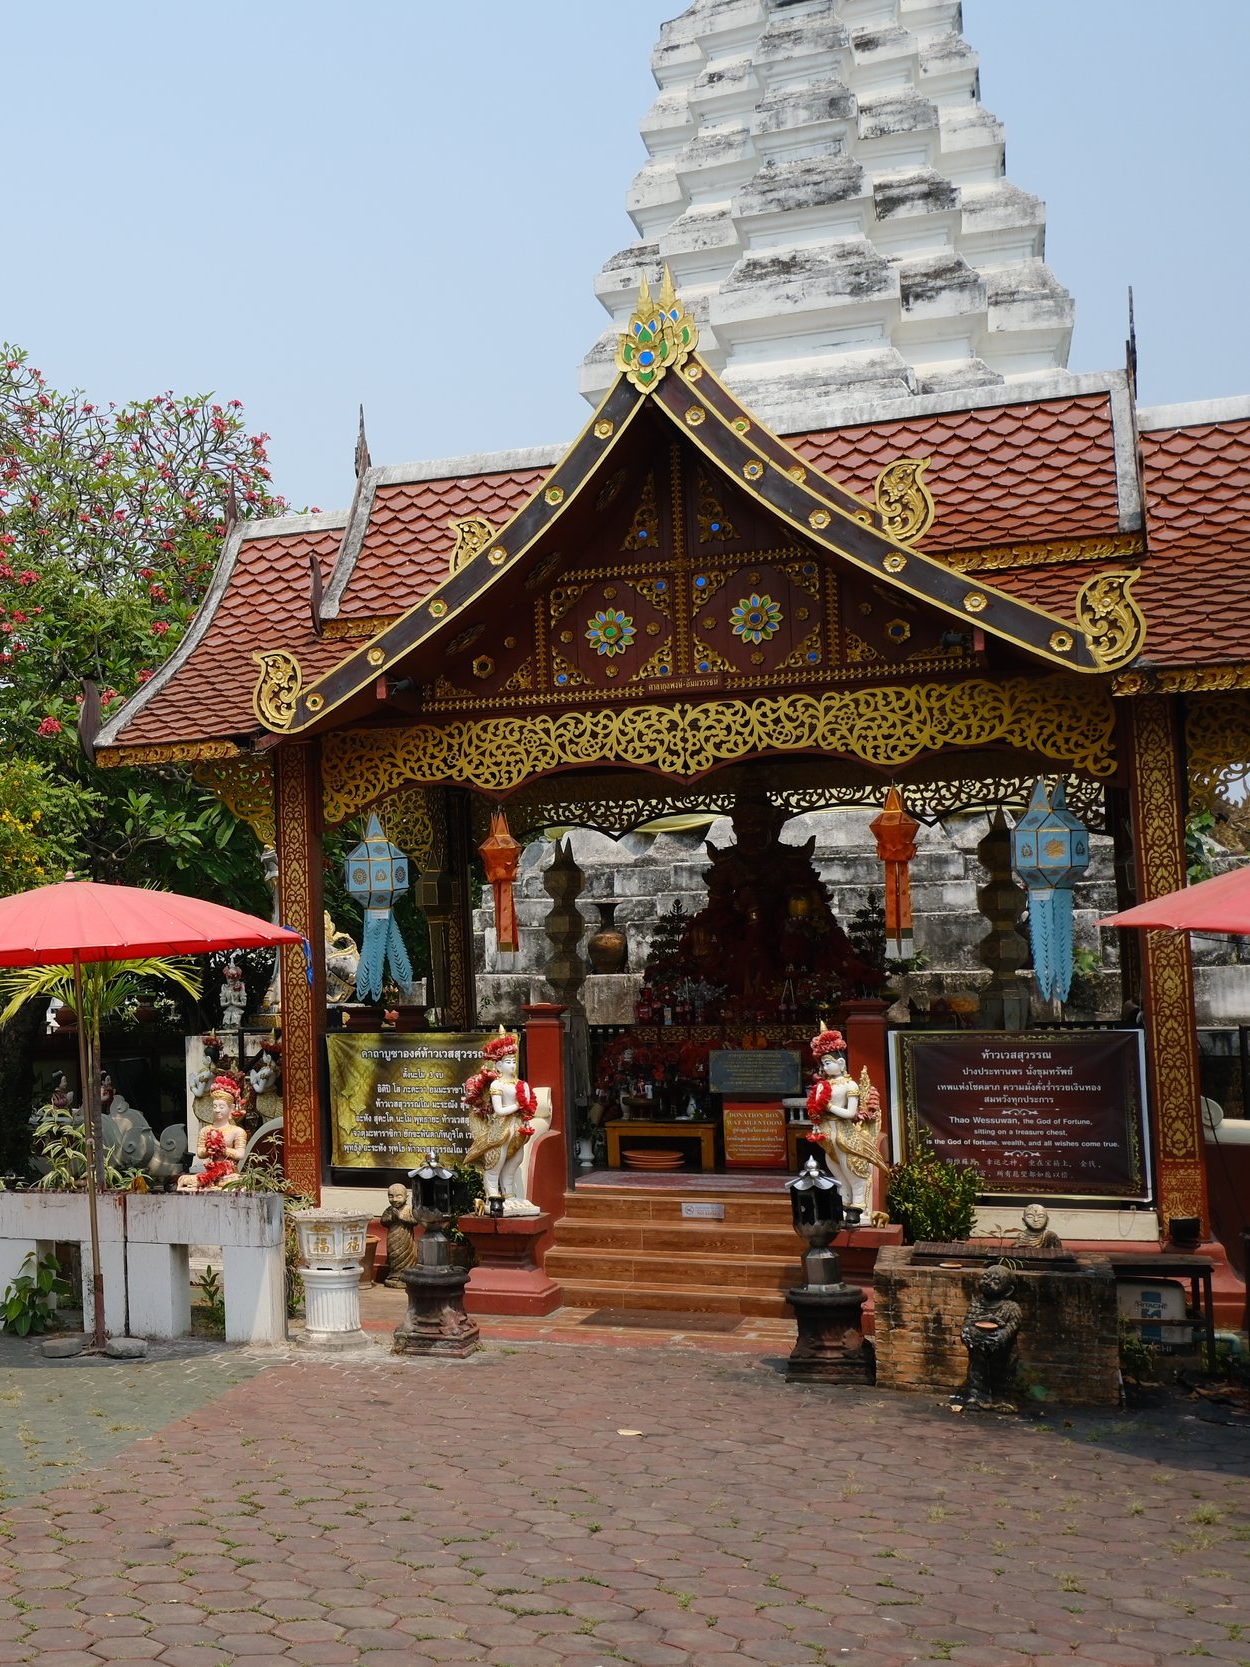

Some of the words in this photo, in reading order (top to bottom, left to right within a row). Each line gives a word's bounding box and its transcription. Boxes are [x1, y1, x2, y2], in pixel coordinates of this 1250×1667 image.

[981, 1048, 1052, 1063] ท้าวเวสสุวรรณ
[962, 1066, 1023, 1076] ปางประทานพร
[983, 1094, 1054, 1106] สมหวังทุกประการ
[948, 1116, 970, 1124] Thao
[972, 1116, 1020, 1126] Wessuwan,
[1063, 1118, 1093, 1127] Fortune,
[973, 1128, 996, 1137] sitting
[1046, 1129, 1068, 1137] chest,
[947, 1138, 962, 1146] God
[972, 1138, 1000, 1147] fortune,
[1028, 1139, 1042, 1147] and
[1043, 1139, 1053, 1147] all
